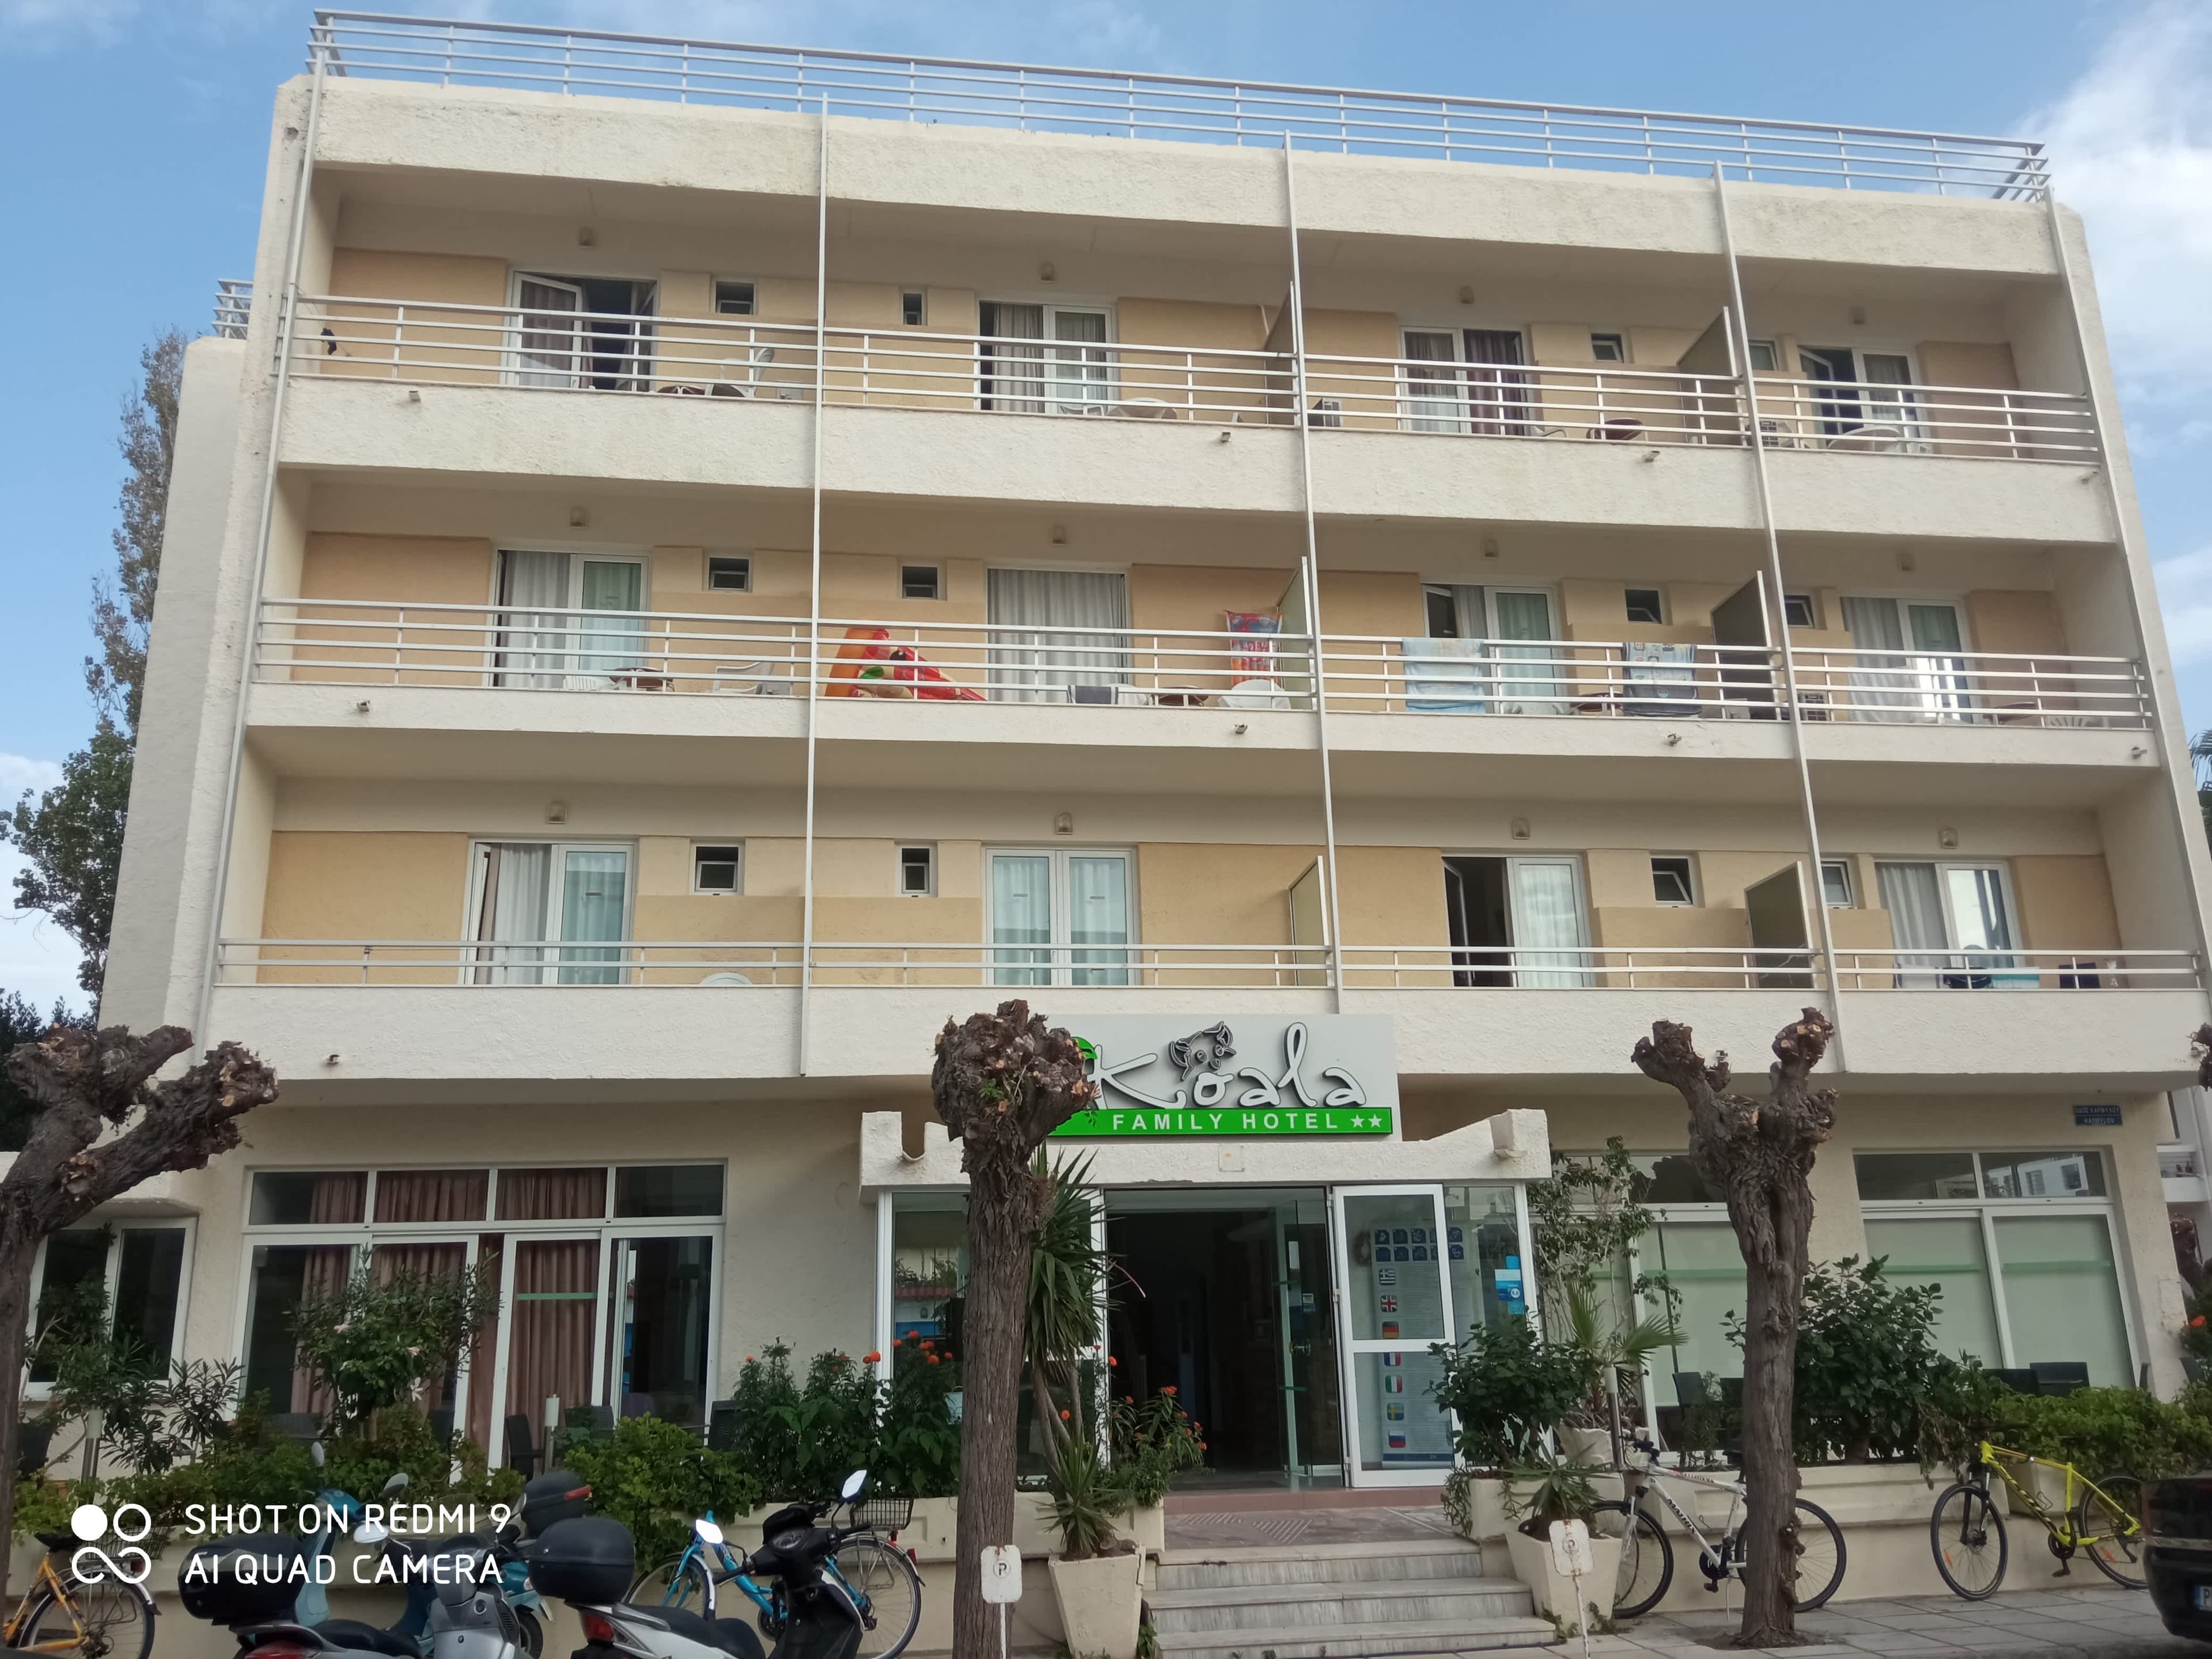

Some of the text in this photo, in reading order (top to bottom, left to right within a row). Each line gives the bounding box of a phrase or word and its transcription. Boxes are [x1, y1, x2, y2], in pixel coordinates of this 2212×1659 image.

[1087, 1021, 1367, 1110] Koala
[1112, 1112, 1338, 1130] FAMILY HOTEL
[998, 1562, 1007, 1576] P
[2203, 1588, 2212, 1605] P
